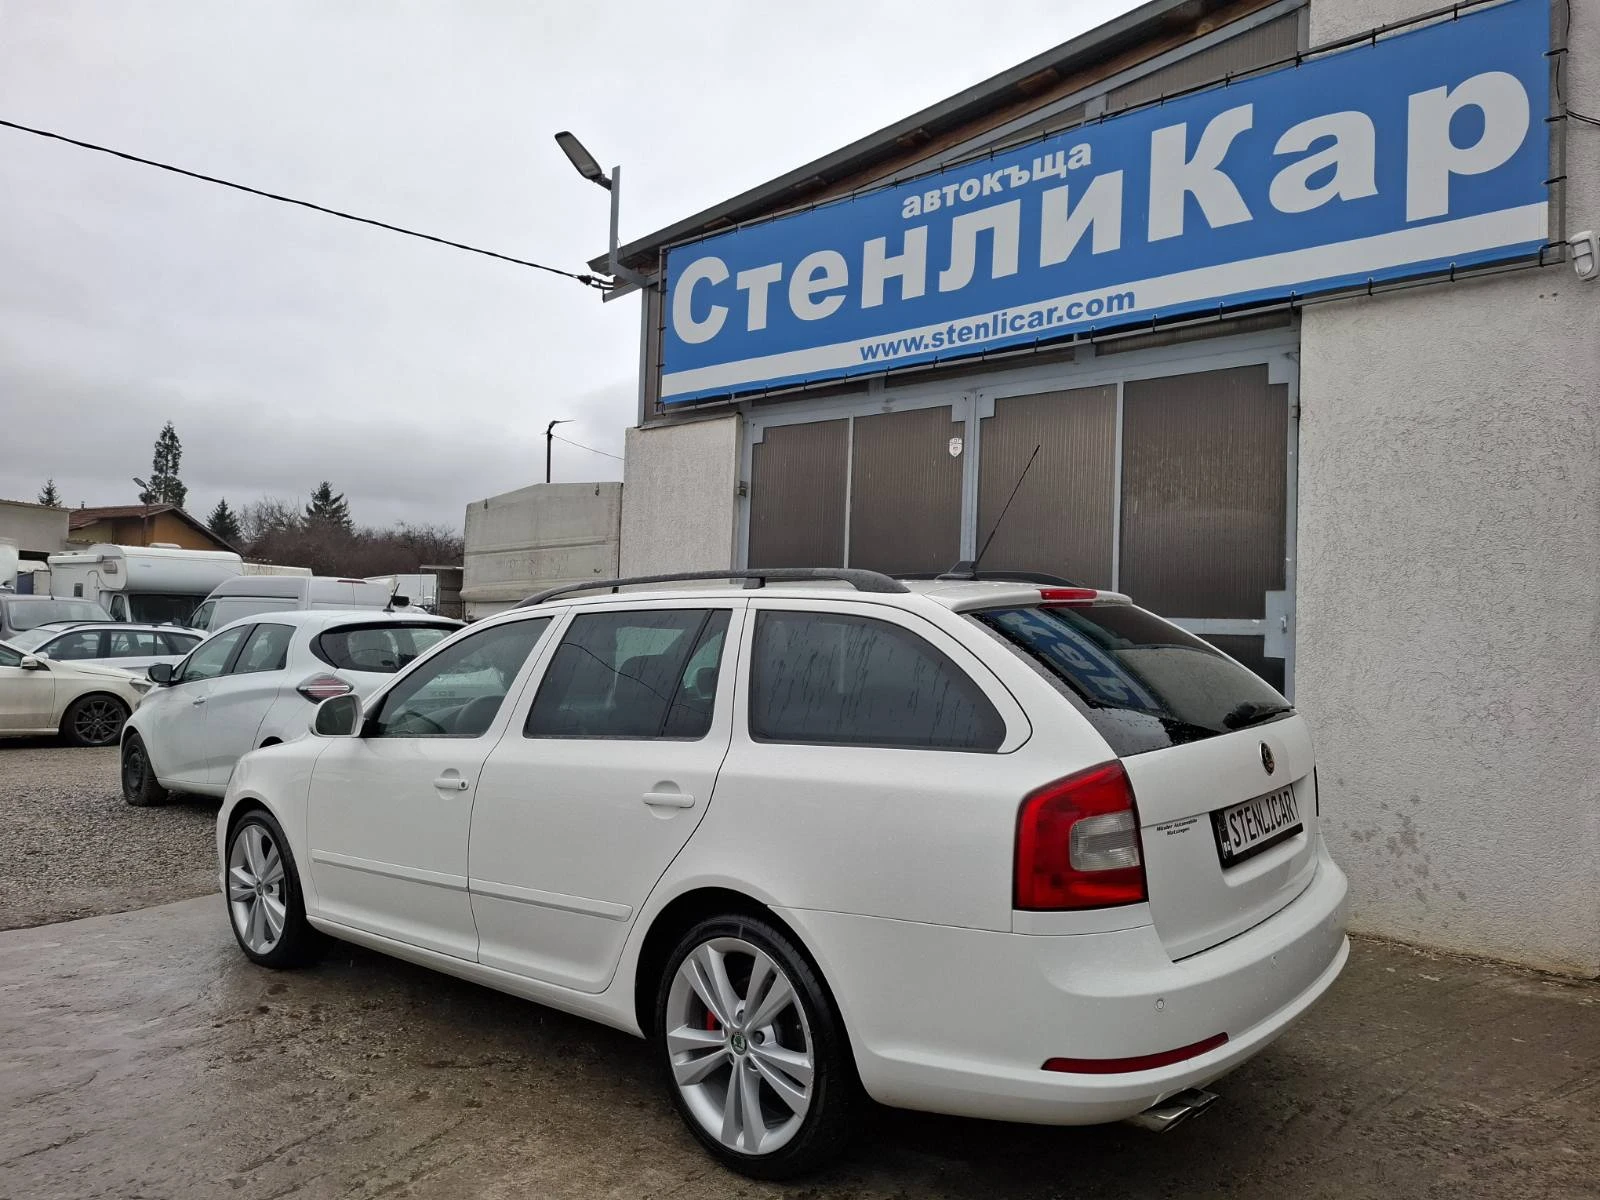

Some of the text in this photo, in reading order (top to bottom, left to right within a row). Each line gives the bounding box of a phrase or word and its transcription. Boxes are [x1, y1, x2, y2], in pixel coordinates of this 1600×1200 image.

[672, 71, 1530, 344] СтенлиКар
[902, 142, 1092, 220] автокъща
[860, 292, 1135, 361] www.stenlicar.com
[1229, 790, 1295, 848] STENLICAR
